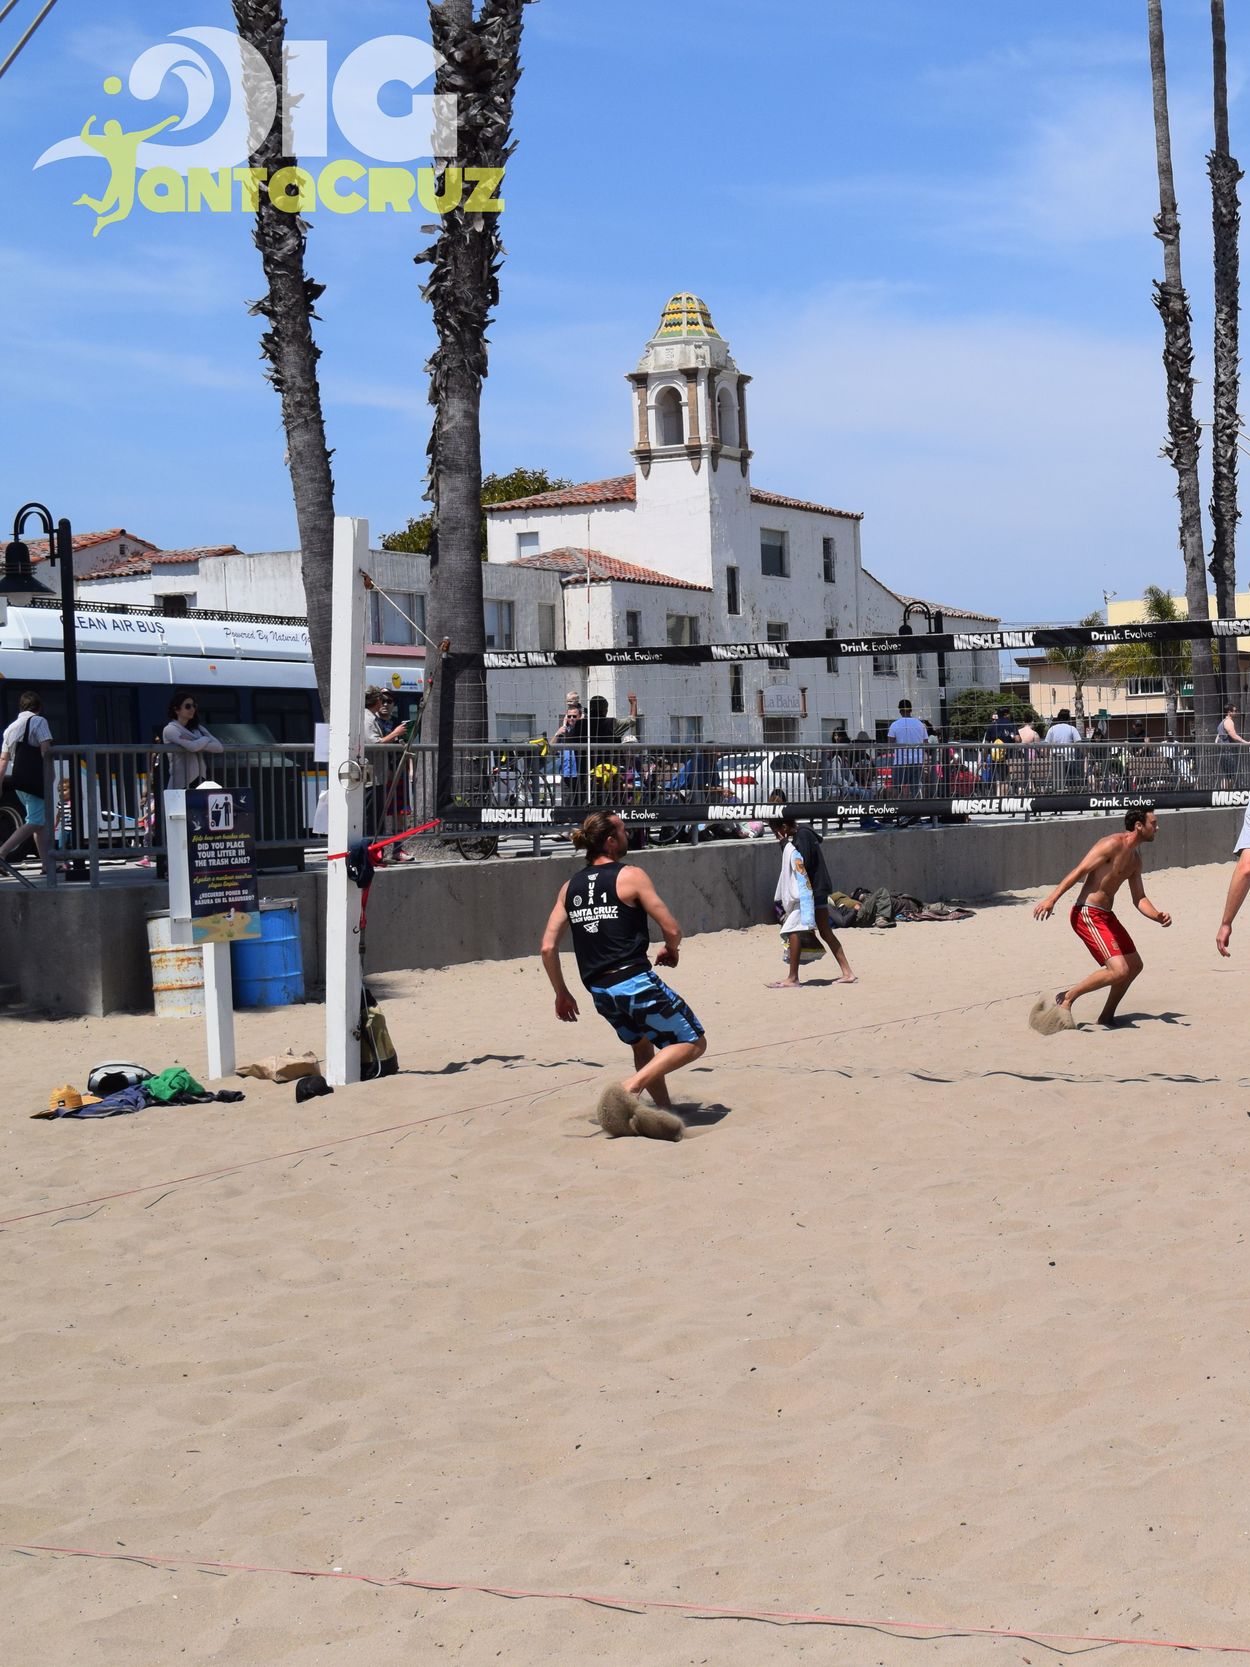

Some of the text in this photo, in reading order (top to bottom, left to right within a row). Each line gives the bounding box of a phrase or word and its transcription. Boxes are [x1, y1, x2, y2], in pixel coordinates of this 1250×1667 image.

[60, 615, 165, 634] EAN AIR BUS
[223, 627, 255, 640] Powered
[256, 629, 269, 643] By
[269, 630, 300, 642] Natural
[953, 631, 1035, 650] MUSCLE MILK
[711, 643, 789, 660] MUSCLE MILK
[483, 651, 557, 668] MUSCLE MILK
[708, 805, 784, 820] MUSCLE MILK
[951, 798, 1033, 814] MUSCLE MILK
[481, 808, 553, 823] MUSCLE MILK
[195, 856, 250, 867] THE TRASH CANS?
[195, 898, 213, 906] BASURA
[600, 892, 607, 903] 1
[569, 905, 619, 919] SANTA CRUZ
